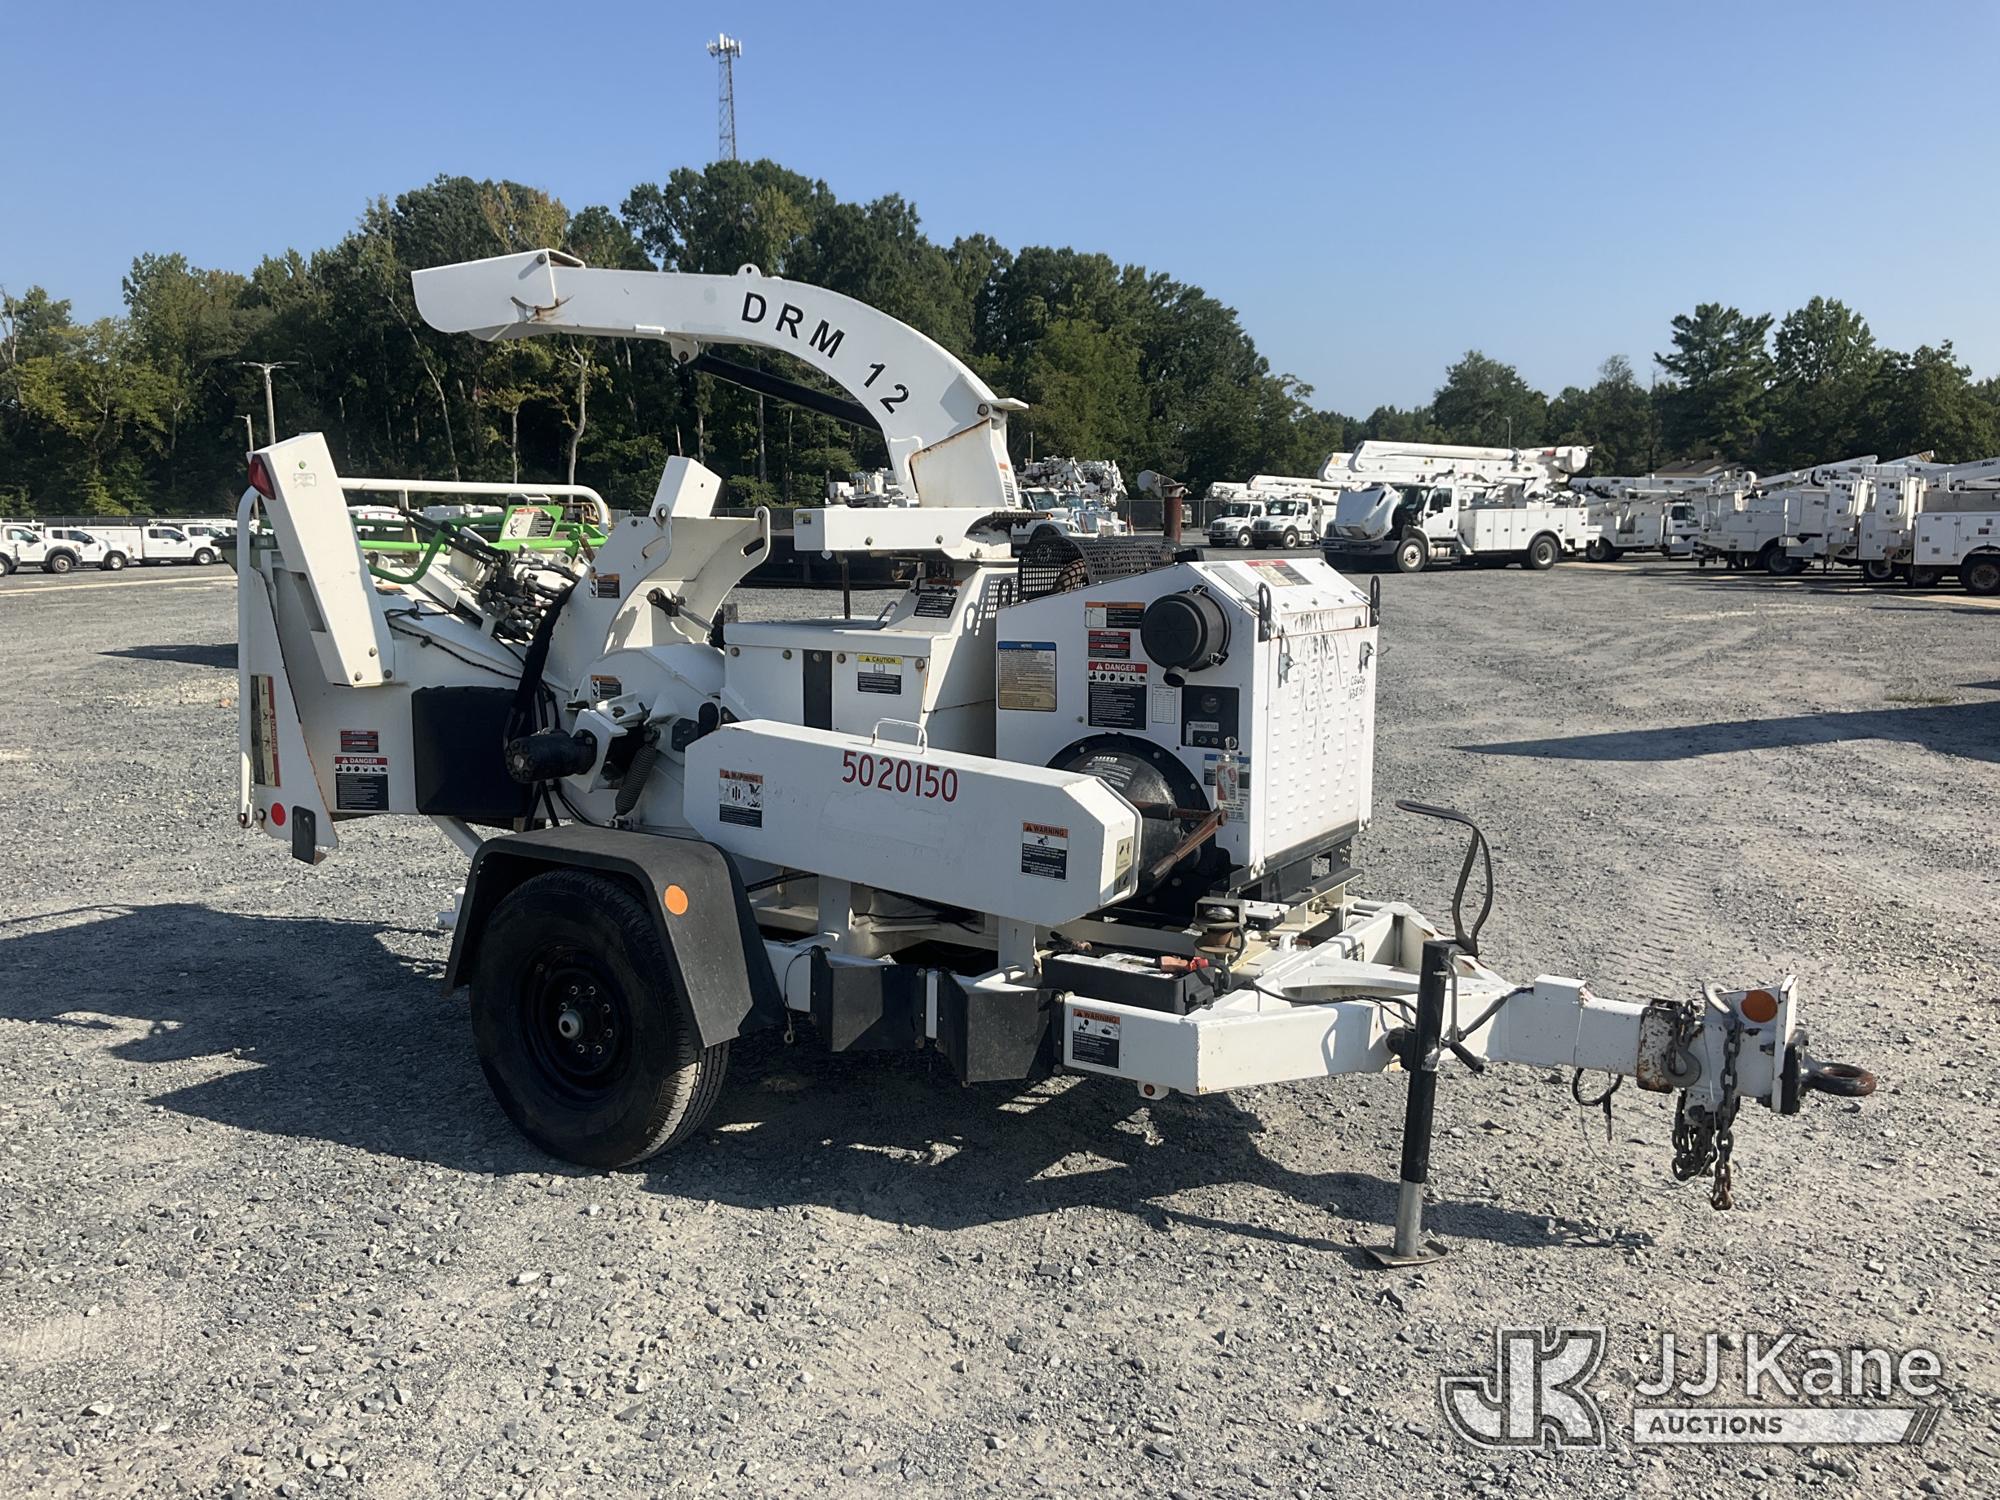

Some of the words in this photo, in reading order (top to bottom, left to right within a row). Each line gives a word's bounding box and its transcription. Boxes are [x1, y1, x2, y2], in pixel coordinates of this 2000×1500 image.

[741, 291, 845, 359] DRM
[863, 362, 909, 415] 12
[872, 655, 896, 664] CAUTION
[1104, 663, 1136, 672] DANGER
[349, 757, 378, 765] DANGER
[842, 750, 958, 802] 5020150
[1033, 824, 1066, 837] WARNING
[1083, 1011, 1118, 1024] WARNING
